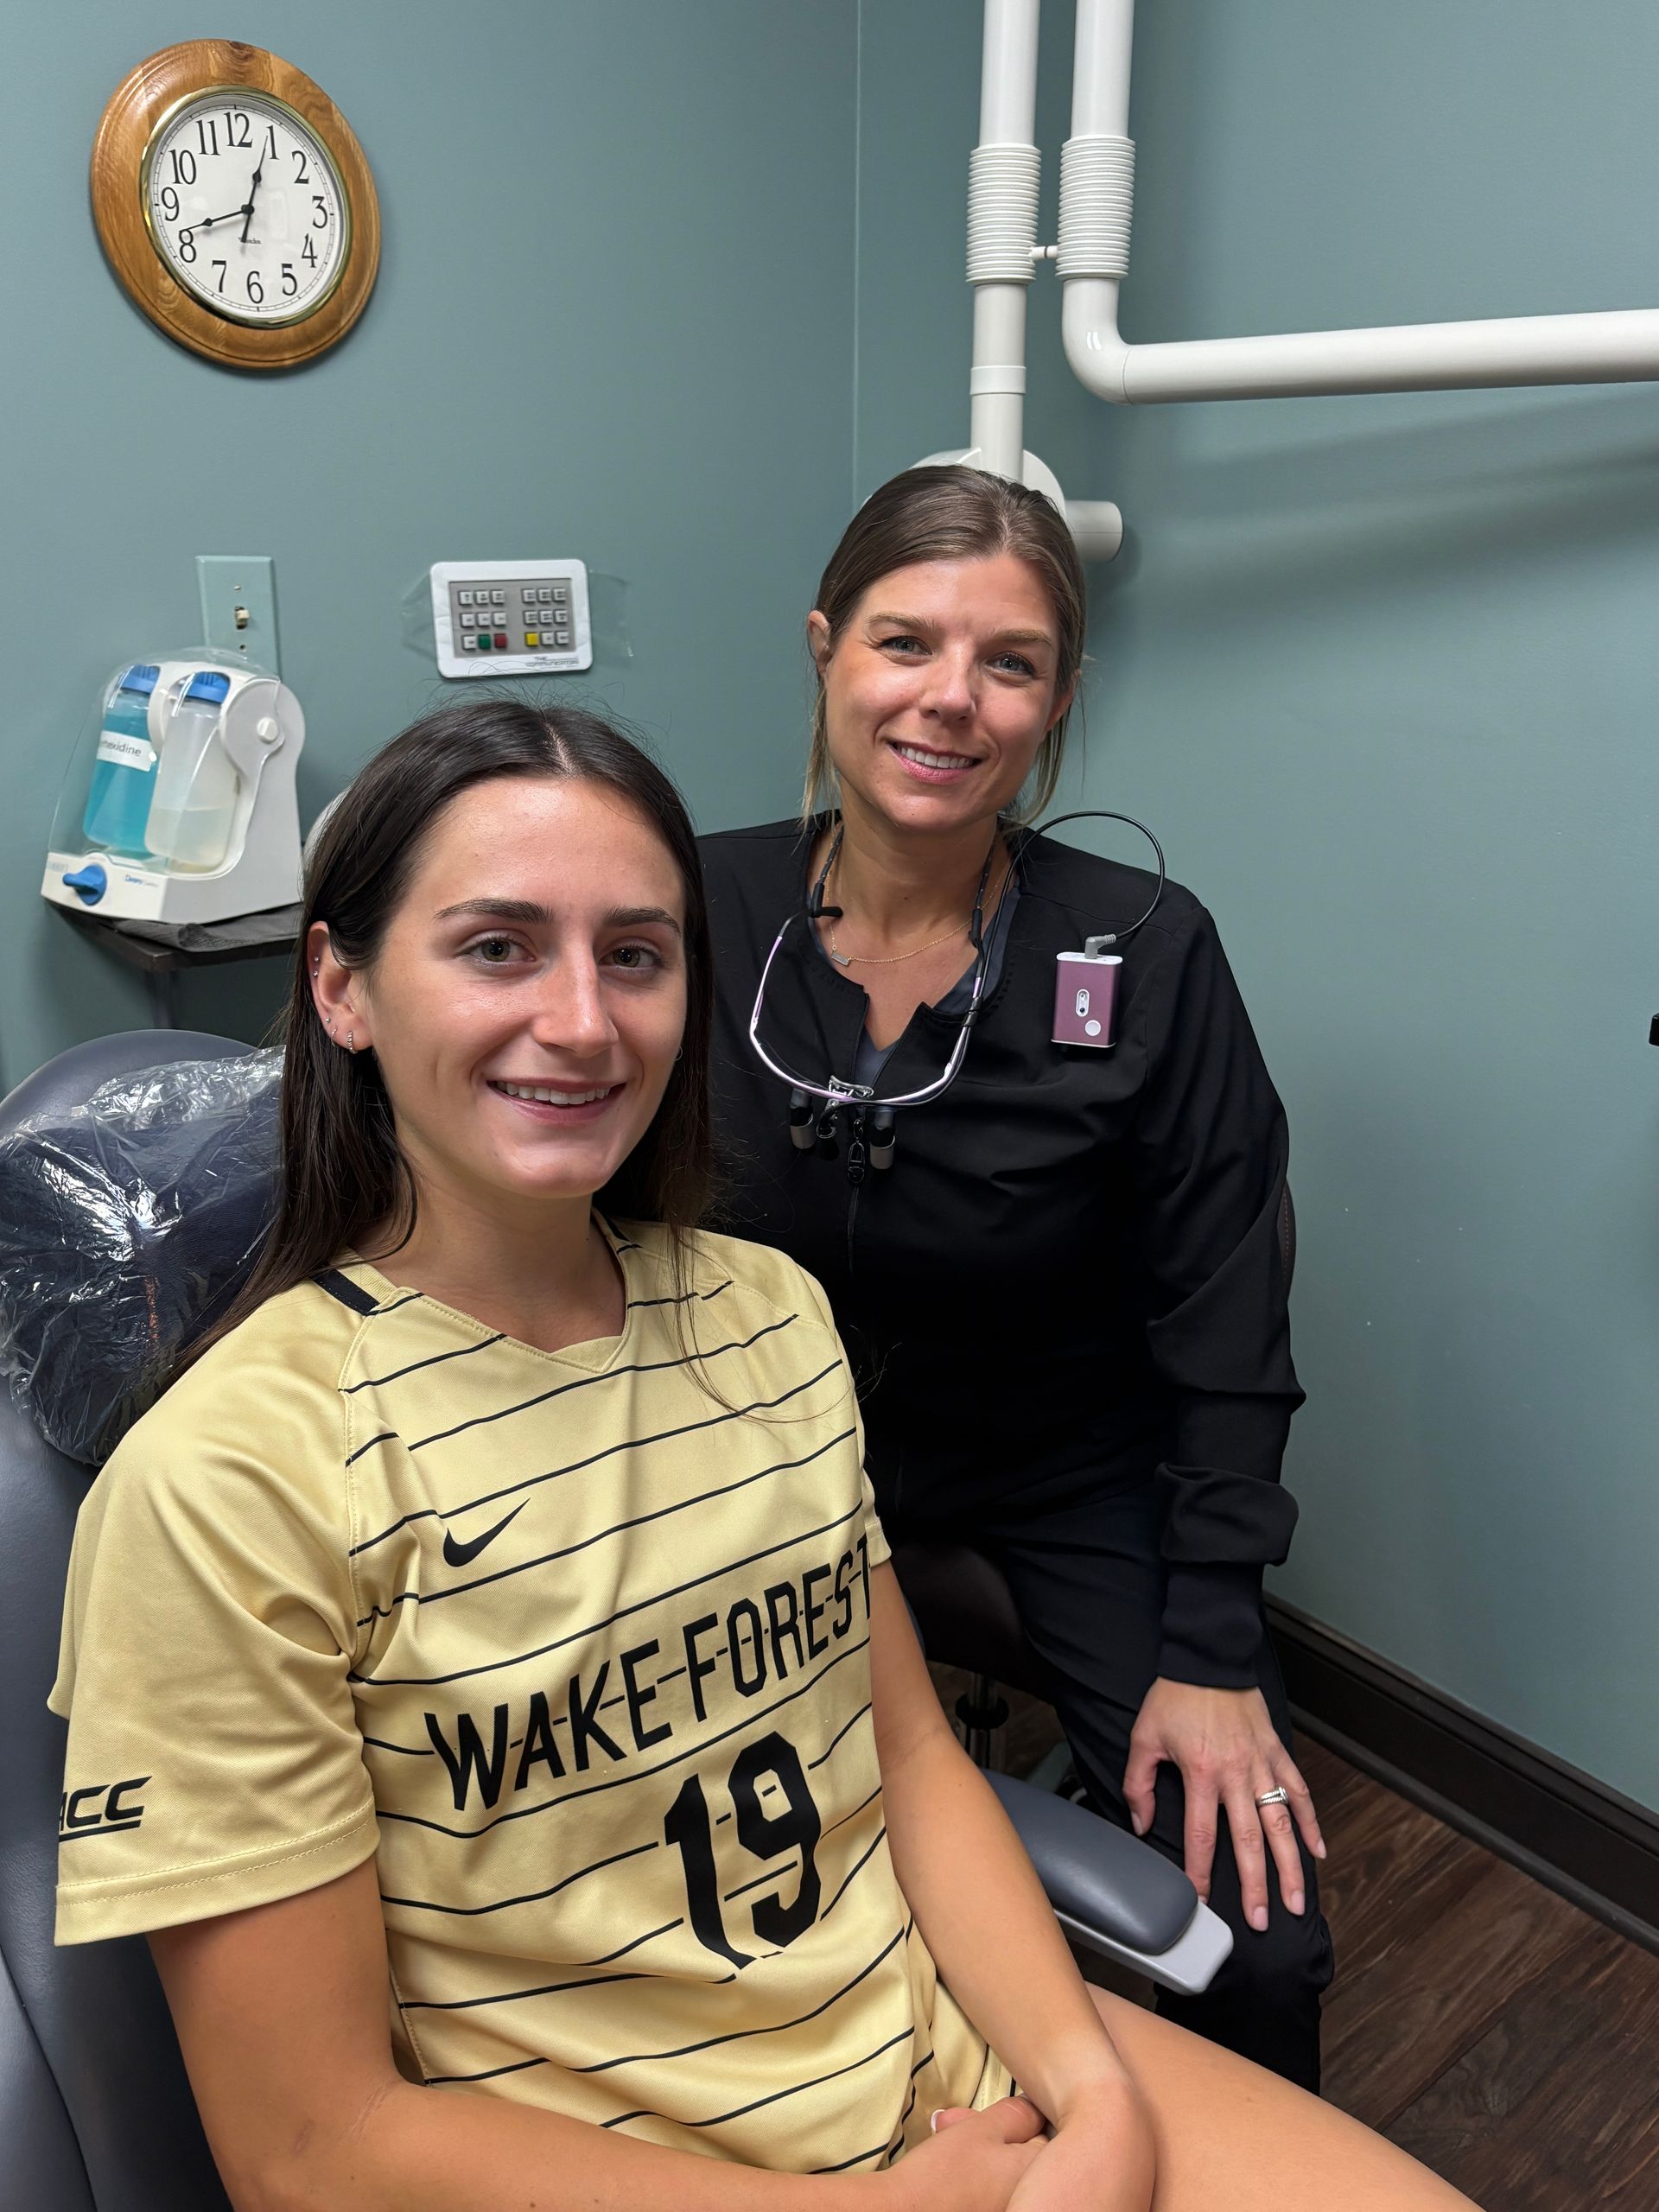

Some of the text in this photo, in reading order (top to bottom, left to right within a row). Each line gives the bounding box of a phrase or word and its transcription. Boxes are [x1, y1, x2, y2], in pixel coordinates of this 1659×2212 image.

[196, 119, 221, 156] 11
[225, 111, 253, 148] 12
[266, 124, 279, 160] 1
[168, 149, 197, 185] 10
[292, 150, 309, 184] 2
[161, 187, 180, 221] 9
[312, 195, 328, 229] 3
[178, 229, 197, 263] 8
[302, 233, 318, 268] 4
[212, 260, 226, 293] 7
[246, 270, 264, 304] 6
[282, 263, 297, 296] 5
[423, 1532, 872, 1812] WAKE FOREST
[664, 1731, 822, 1970] 19
